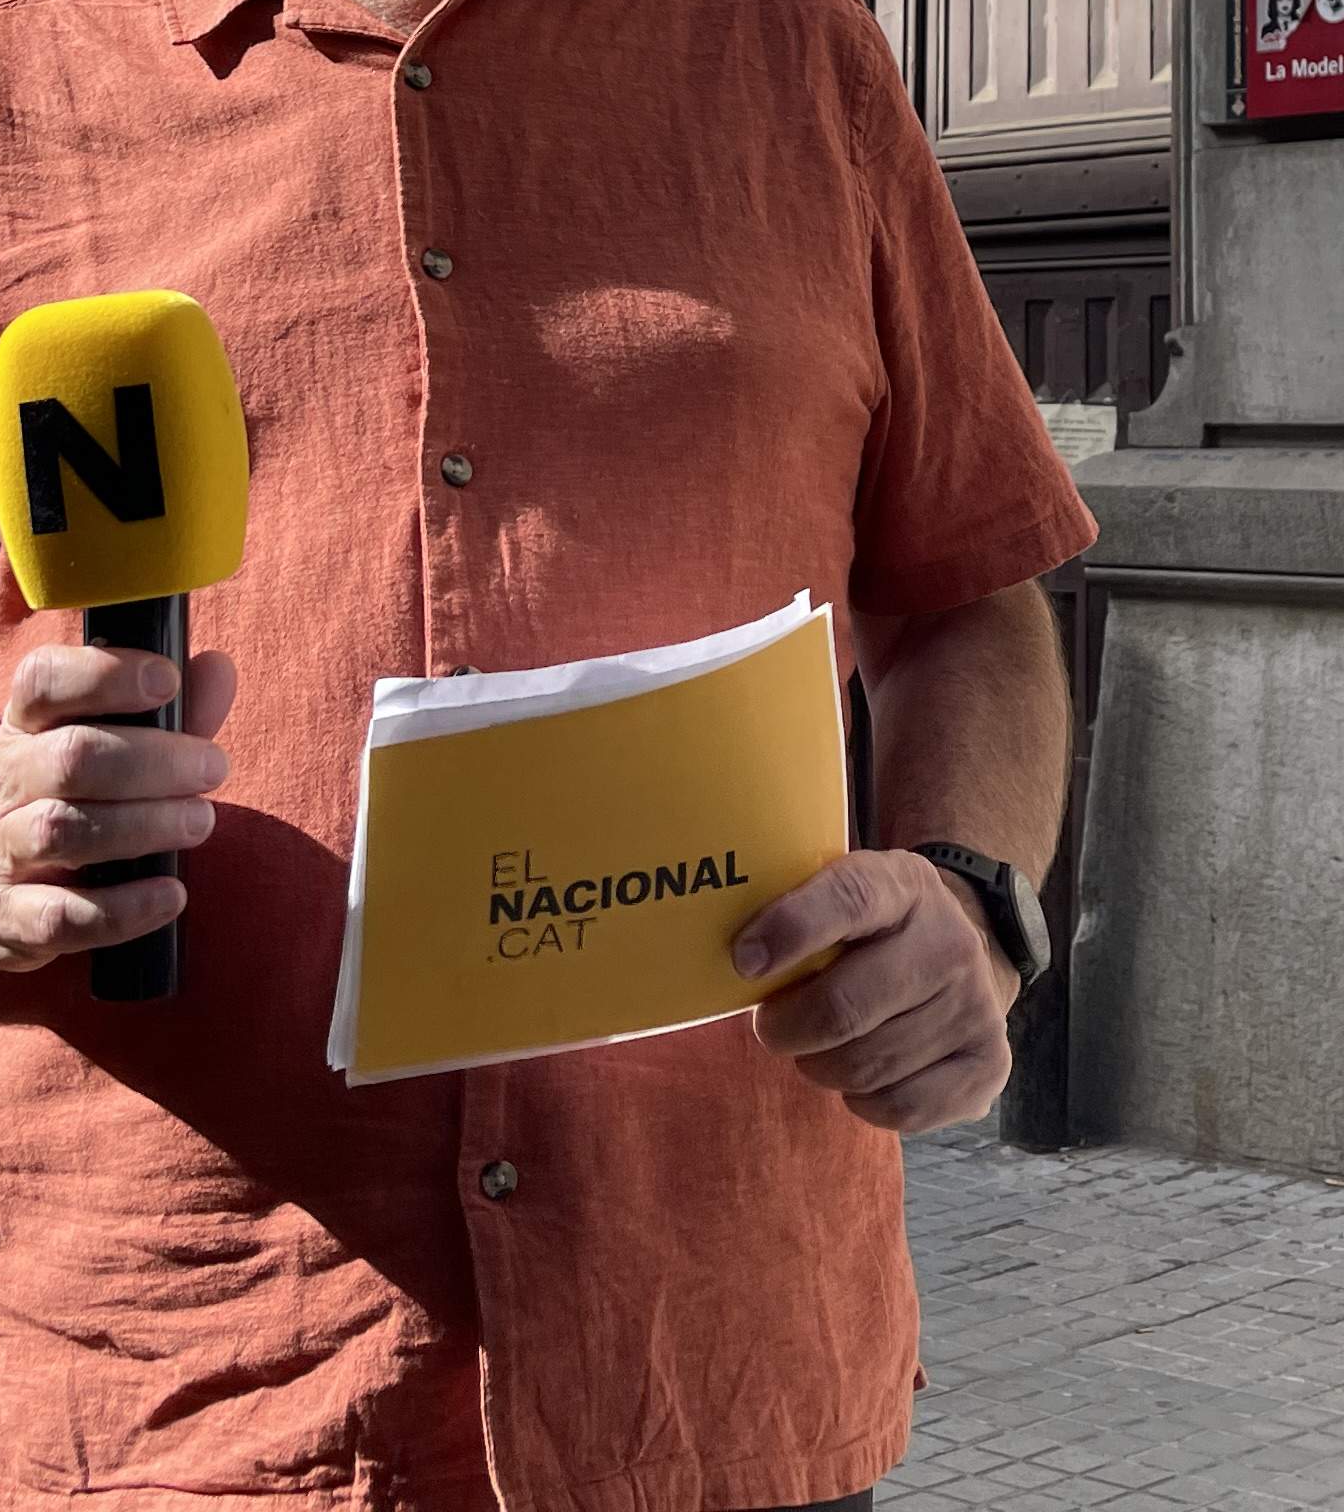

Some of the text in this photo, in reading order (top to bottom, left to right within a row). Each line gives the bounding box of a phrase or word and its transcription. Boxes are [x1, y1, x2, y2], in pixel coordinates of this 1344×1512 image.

[1265, 55, 1344, 81] La Model
[19, 383, 166, 535] N
[489, 850, 749, 925] NACIONAL
[492, 849, 547, 887] EL
[486, 917, 598, 962] .CAT
